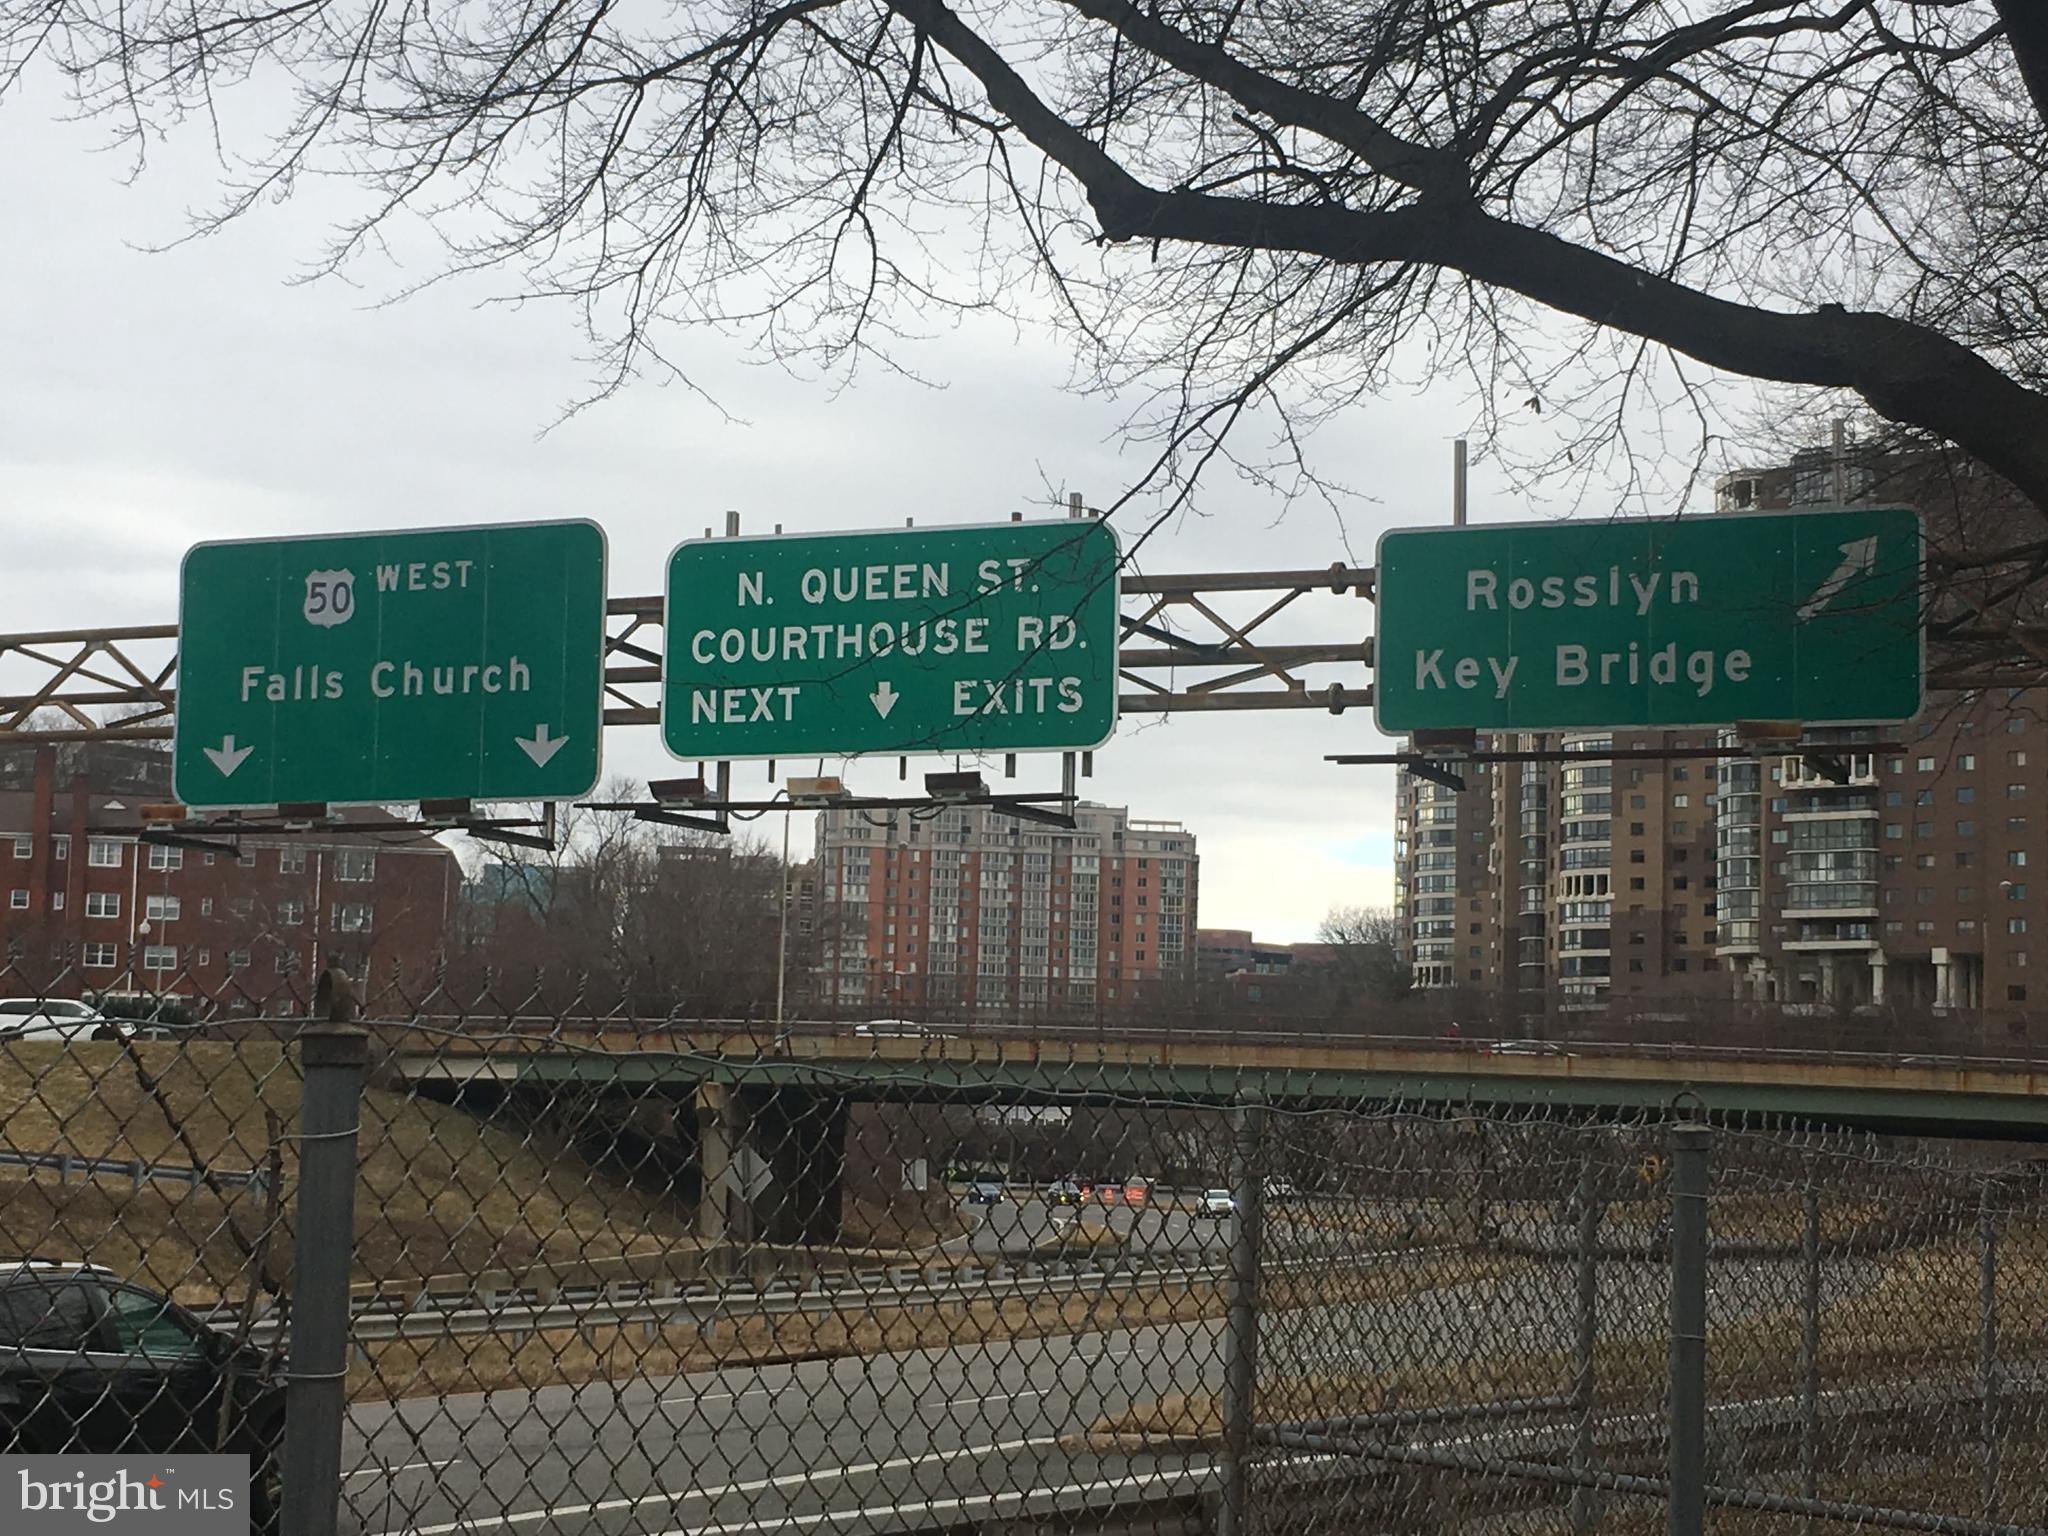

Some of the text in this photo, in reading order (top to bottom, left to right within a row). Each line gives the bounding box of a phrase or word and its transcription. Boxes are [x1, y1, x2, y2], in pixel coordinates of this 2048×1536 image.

[308, 580, 352, 615] 50
[376, 559, 474, 593] WEST
[738, 557, 1040, 607] N. QUEEN ST.
[1466, 565, 1699, 616] Rosslyn
[691, 614, 1088, 664] COURTHOUSE RD.
[240, 656, 531, 703] Falls Church
[1415, 641, 1752, 699] Key Bridge
[691, 676, 1083, 724] NEXT EXITS
